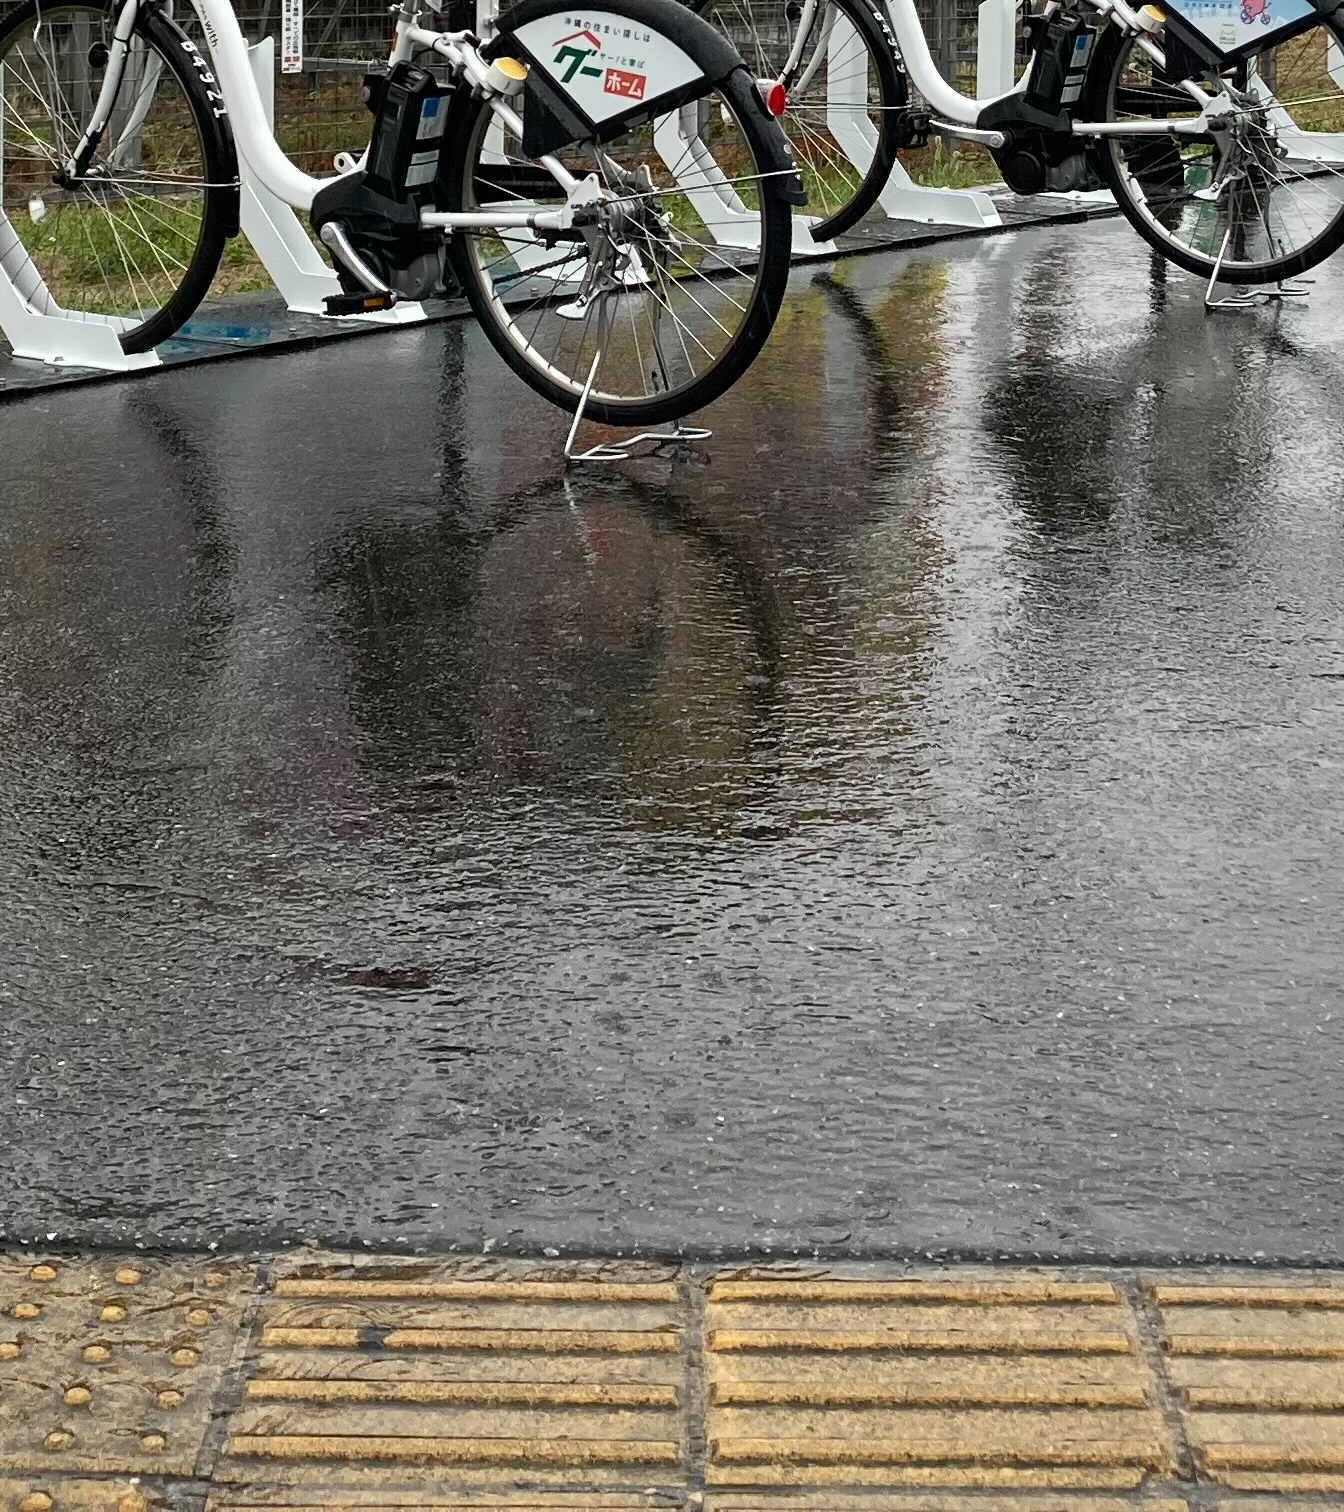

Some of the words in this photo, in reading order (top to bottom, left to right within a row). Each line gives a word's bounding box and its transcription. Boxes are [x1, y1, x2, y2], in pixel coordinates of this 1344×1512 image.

[180, 39, 228, 119] B4921
[552, 44, 604, 84] グー
[606, 71, 643, 97] ホーム
